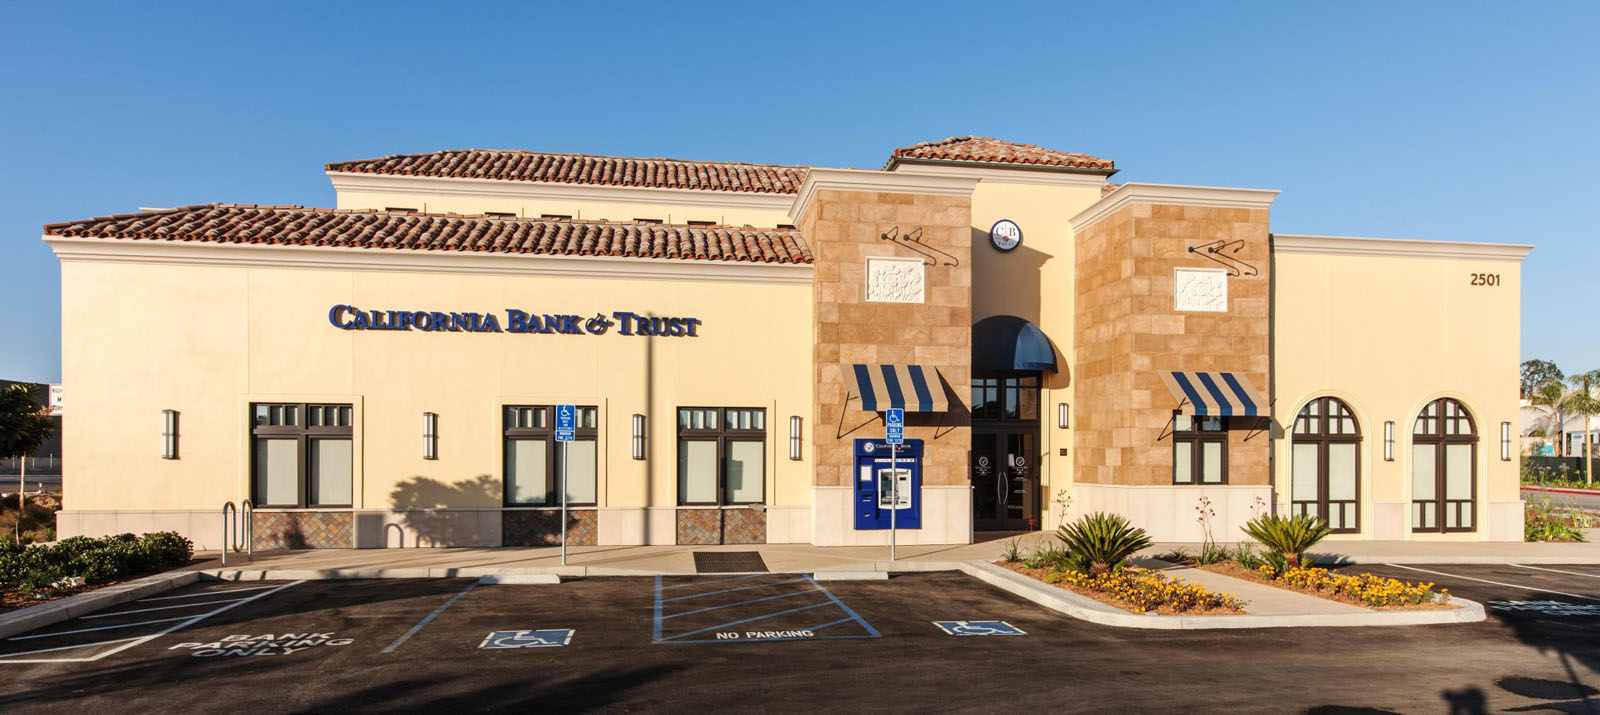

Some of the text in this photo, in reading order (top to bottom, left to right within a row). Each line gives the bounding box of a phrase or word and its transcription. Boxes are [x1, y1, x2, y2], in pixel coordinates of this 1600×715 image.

[1470, 273, 1500, 287] 2501
[329, 304, 503, 332] CALIFORNIA
[505, 309, 584, 334] BANK
[612, 311, 700, 336] TRUST
[220, 632, 335, 642] BANK
[716, 630, 815, 640] NO PARKING
[168, 638, 355, 650] PARKING
[191, 647, 309, 657] ONLY
